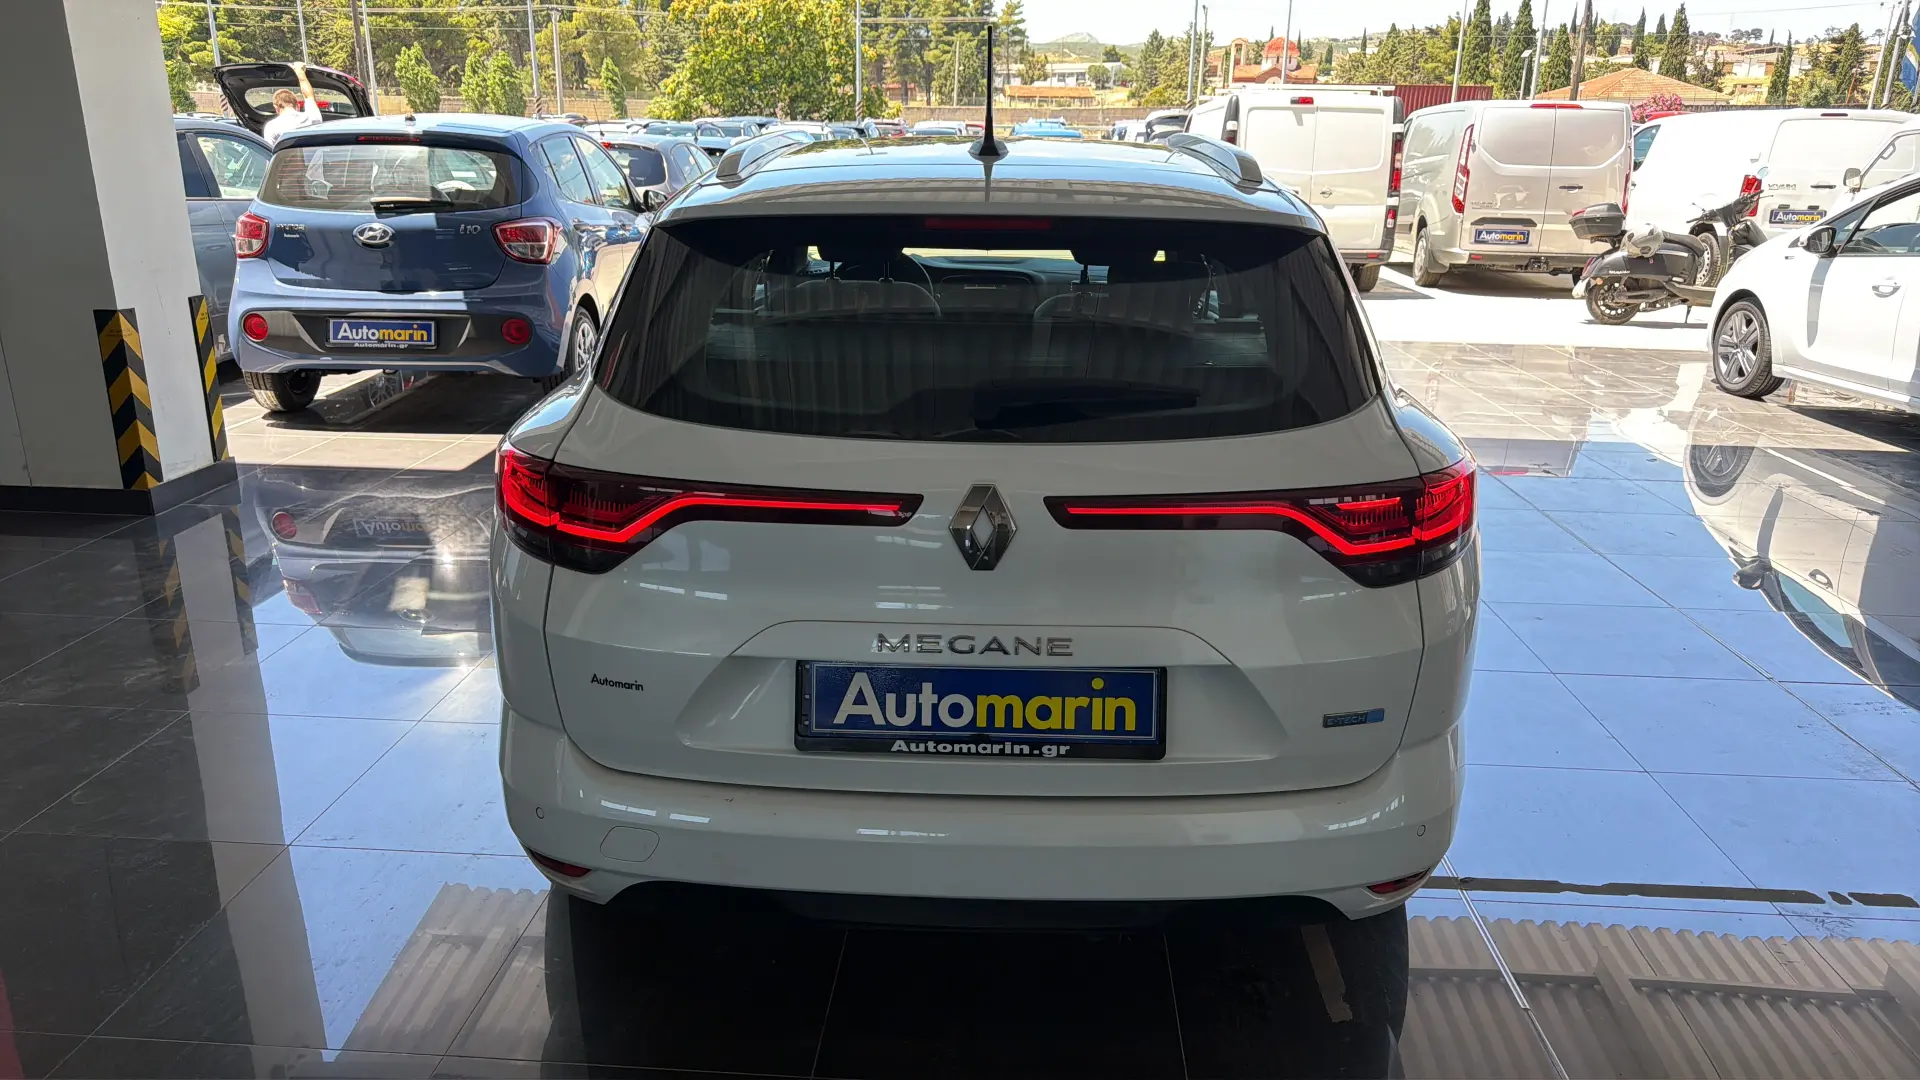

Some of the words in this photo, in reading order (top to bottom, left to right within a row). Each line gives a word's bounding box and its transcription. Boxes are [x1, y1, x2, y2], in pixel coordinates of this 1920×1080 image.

[1776, 211, 1821, 221] Automarin
[1479, 230, 1525, 241] Automarin
[337, 322, 428, 341] Automarin
[876, 633, 1073, 656] MEGANE
[591, 673, 644, 691] Automarin
[833, 672, 1137, 731] Automarin
[891, 739, 1070, 758] Automarin.gr
